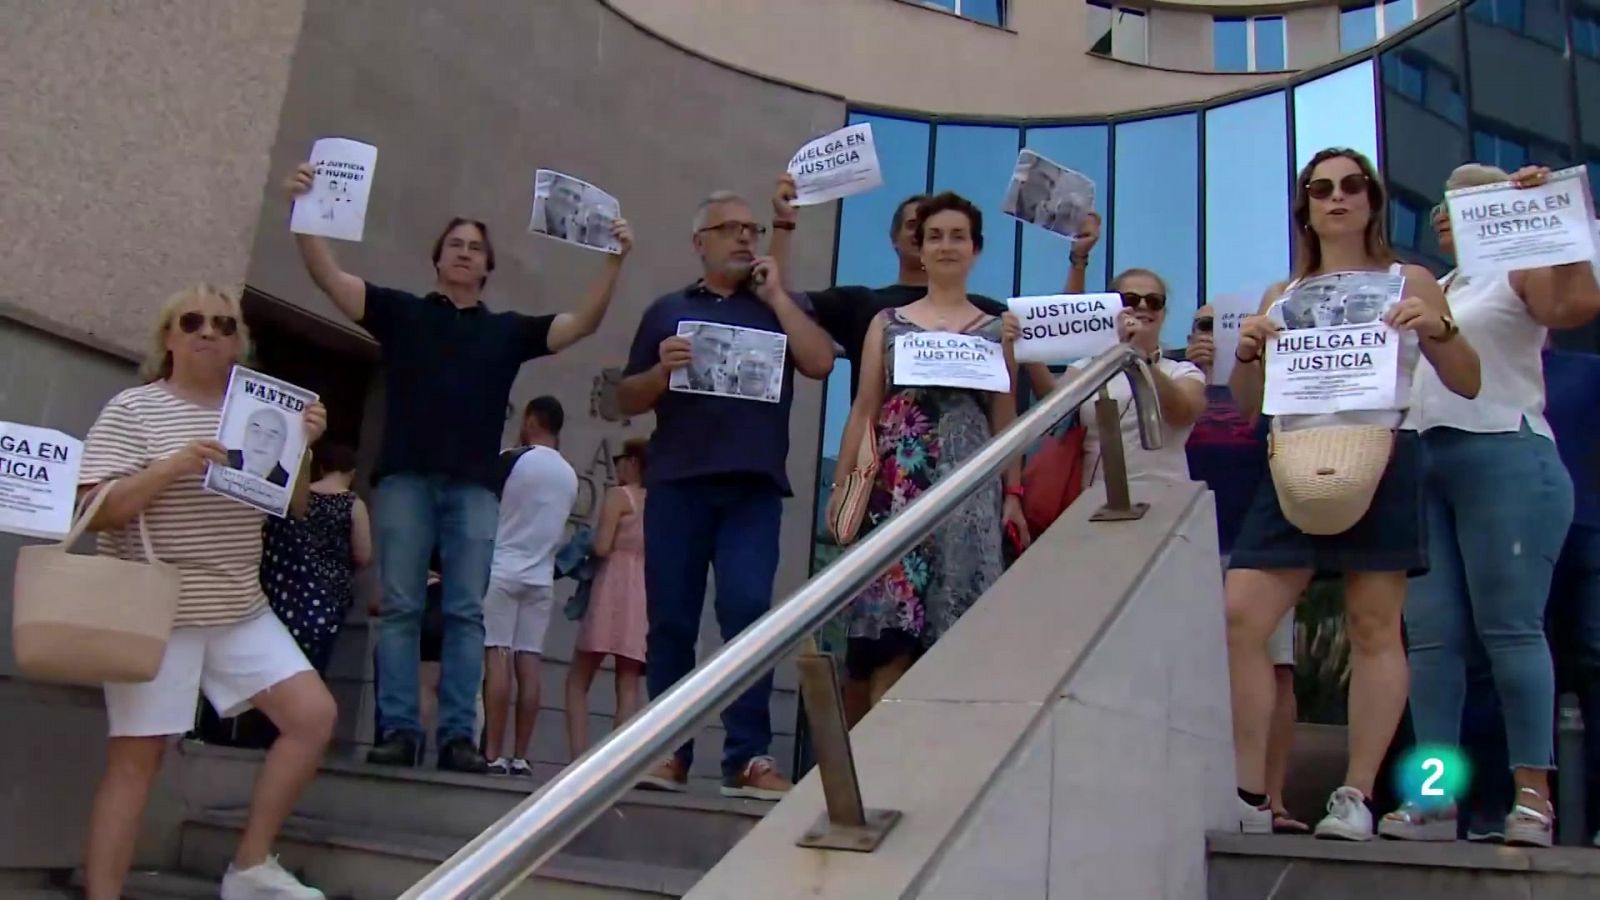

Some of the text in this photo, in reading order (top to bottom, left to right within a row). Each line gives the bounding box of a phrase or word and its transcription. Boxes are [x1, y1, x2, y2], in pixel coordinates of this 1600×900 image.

[790, 132, 866, 168] HUELGA EN
[326, 161, 365, 171] JUSTICIA
[798, 150, 860, 175] JUSTICIA
[1461, 193, 1571, 220] HUELGA EN
[1477, 215, 1562, 237] JUSTICIA
[1026, 301, 1105, 320] JUSTICIA
[1022, 315, 1114, 340] SOLUCIÓN
[903, 338, 969, 348] HUELGA
[1276, 331, 1387, 351] HUELGA EN
[913, 350, 986, 361] JUSTICIA
[1287, 353, 1373, 372] JUSTICIA
[244, 380, 304, 412] WANTED
[38, 443, 68, 461] EN
